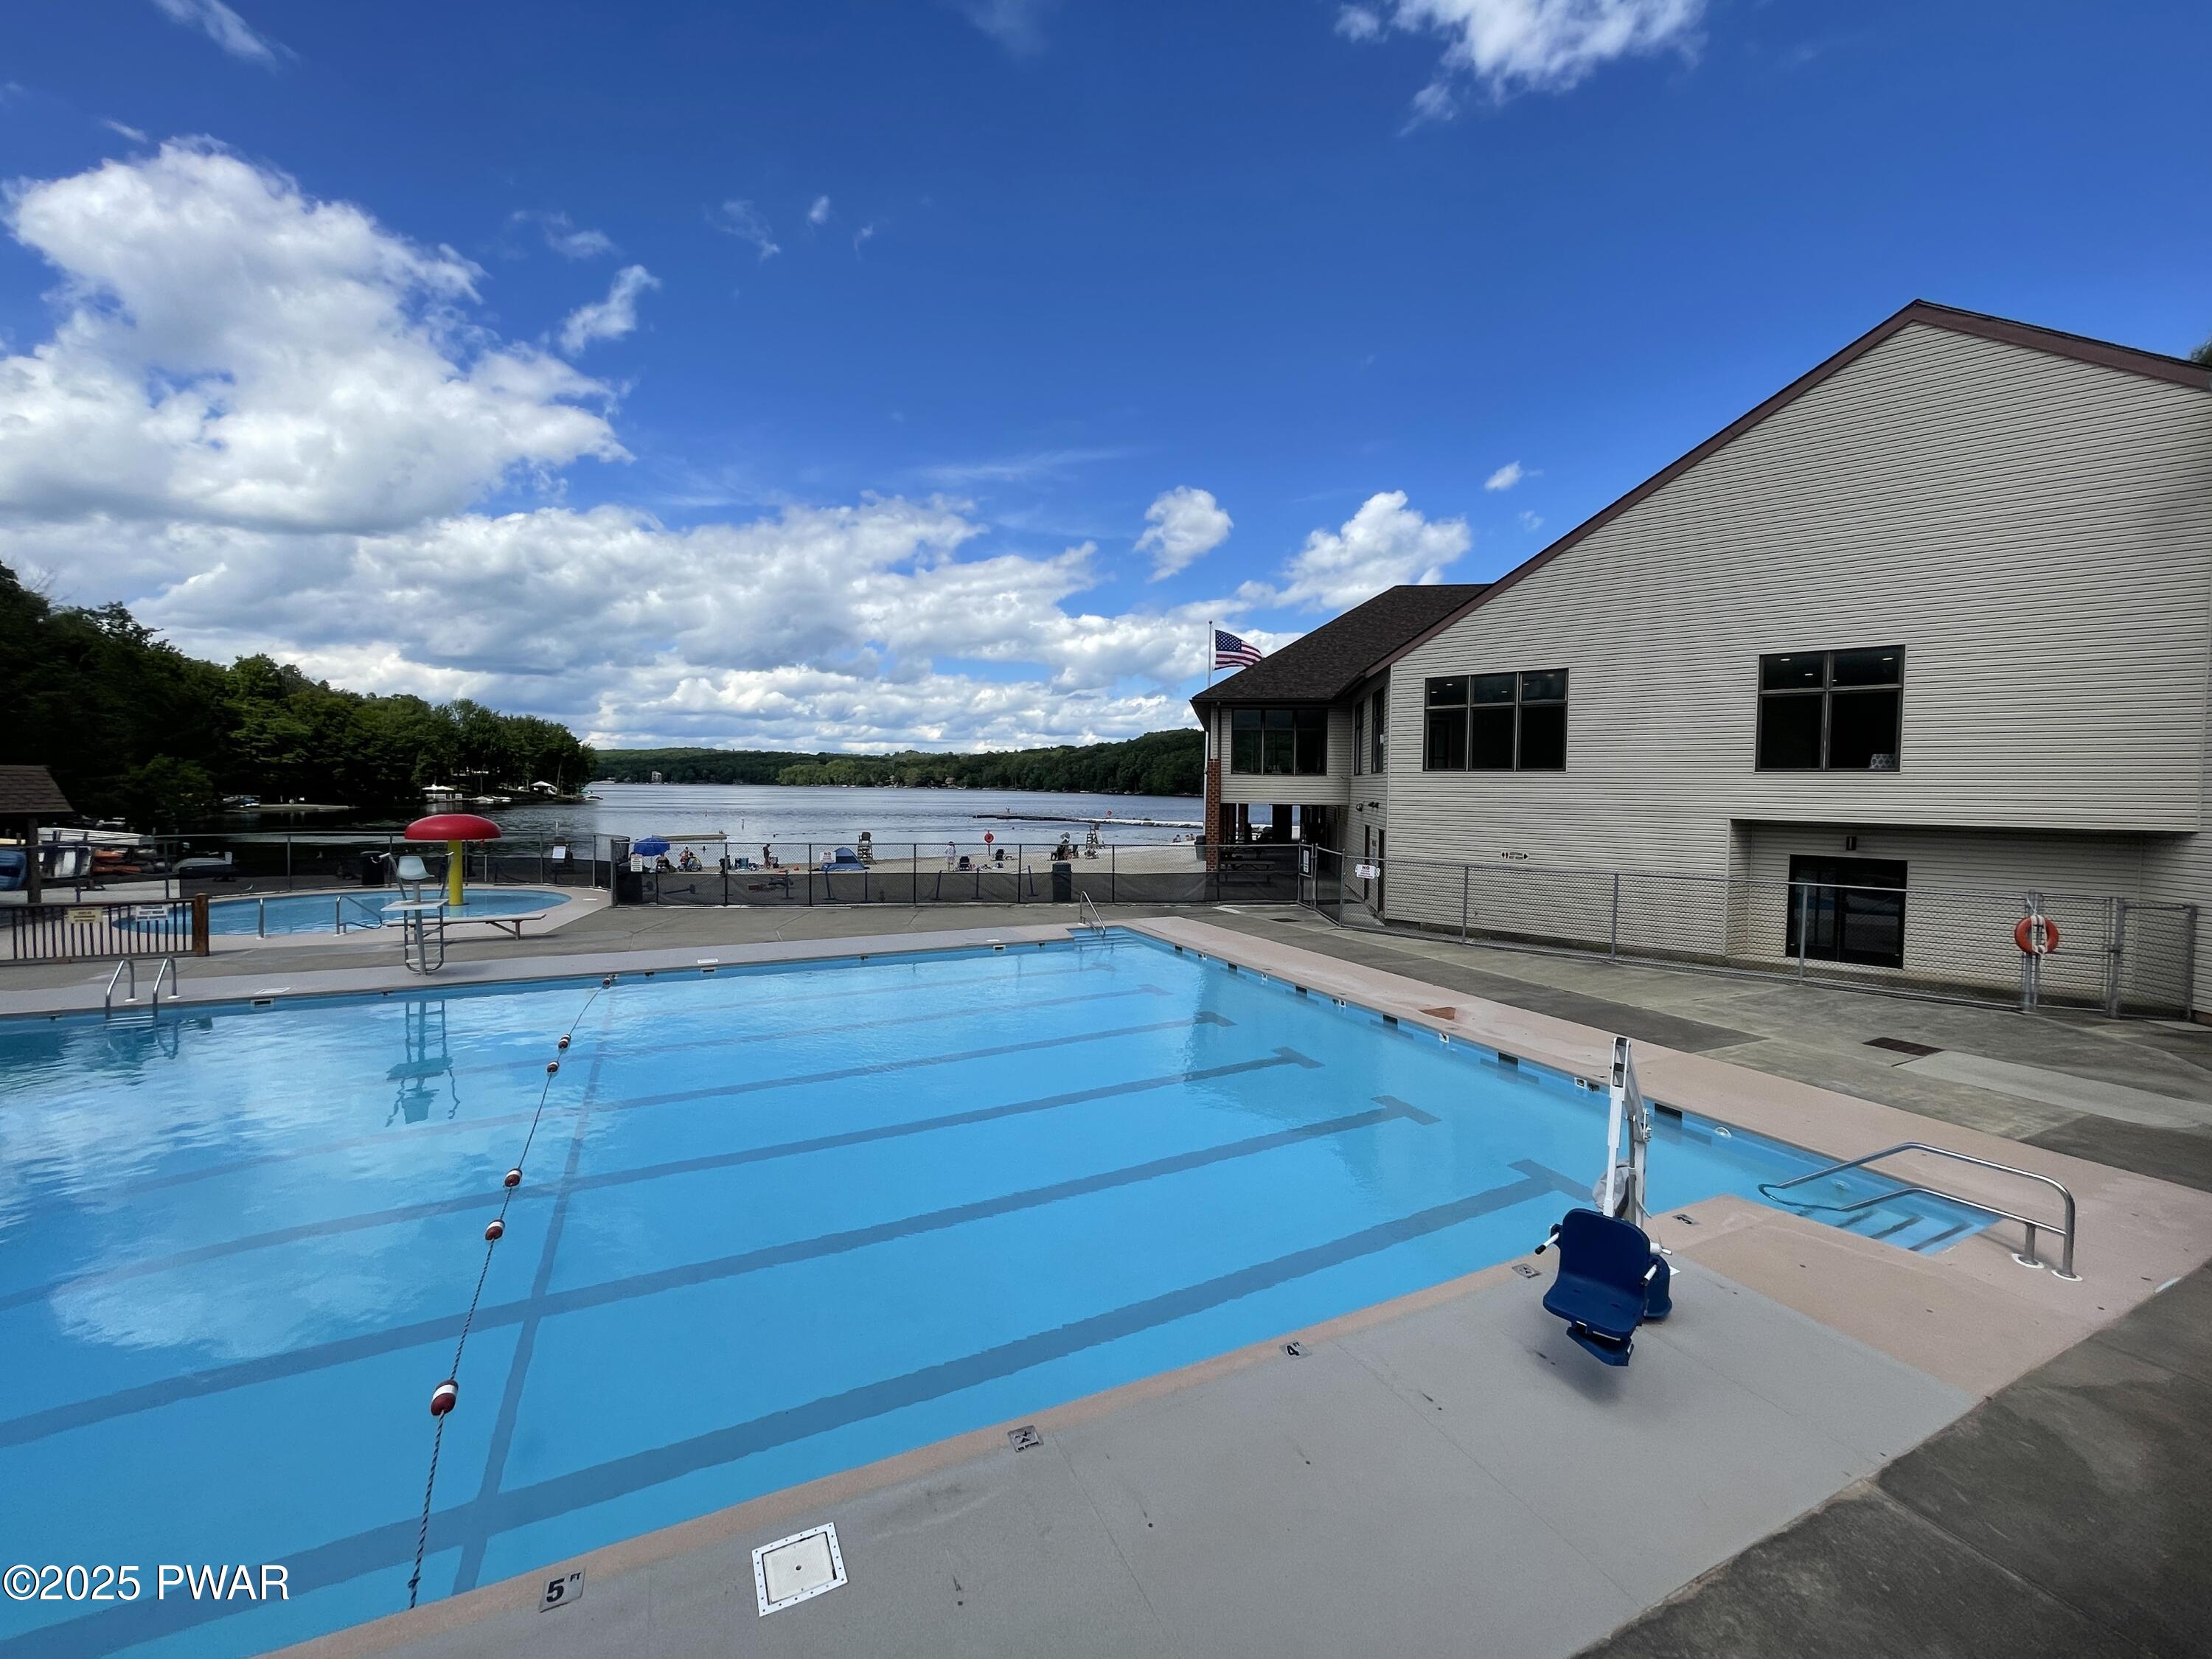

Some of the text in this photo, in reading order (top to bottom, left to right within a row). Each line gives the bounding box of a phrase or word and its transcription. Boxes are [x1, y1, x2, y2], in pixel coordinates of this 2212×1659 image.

[1287, 1345, 1300, 1356] 4
[546, 1571, 582, 1603] 5 FT
